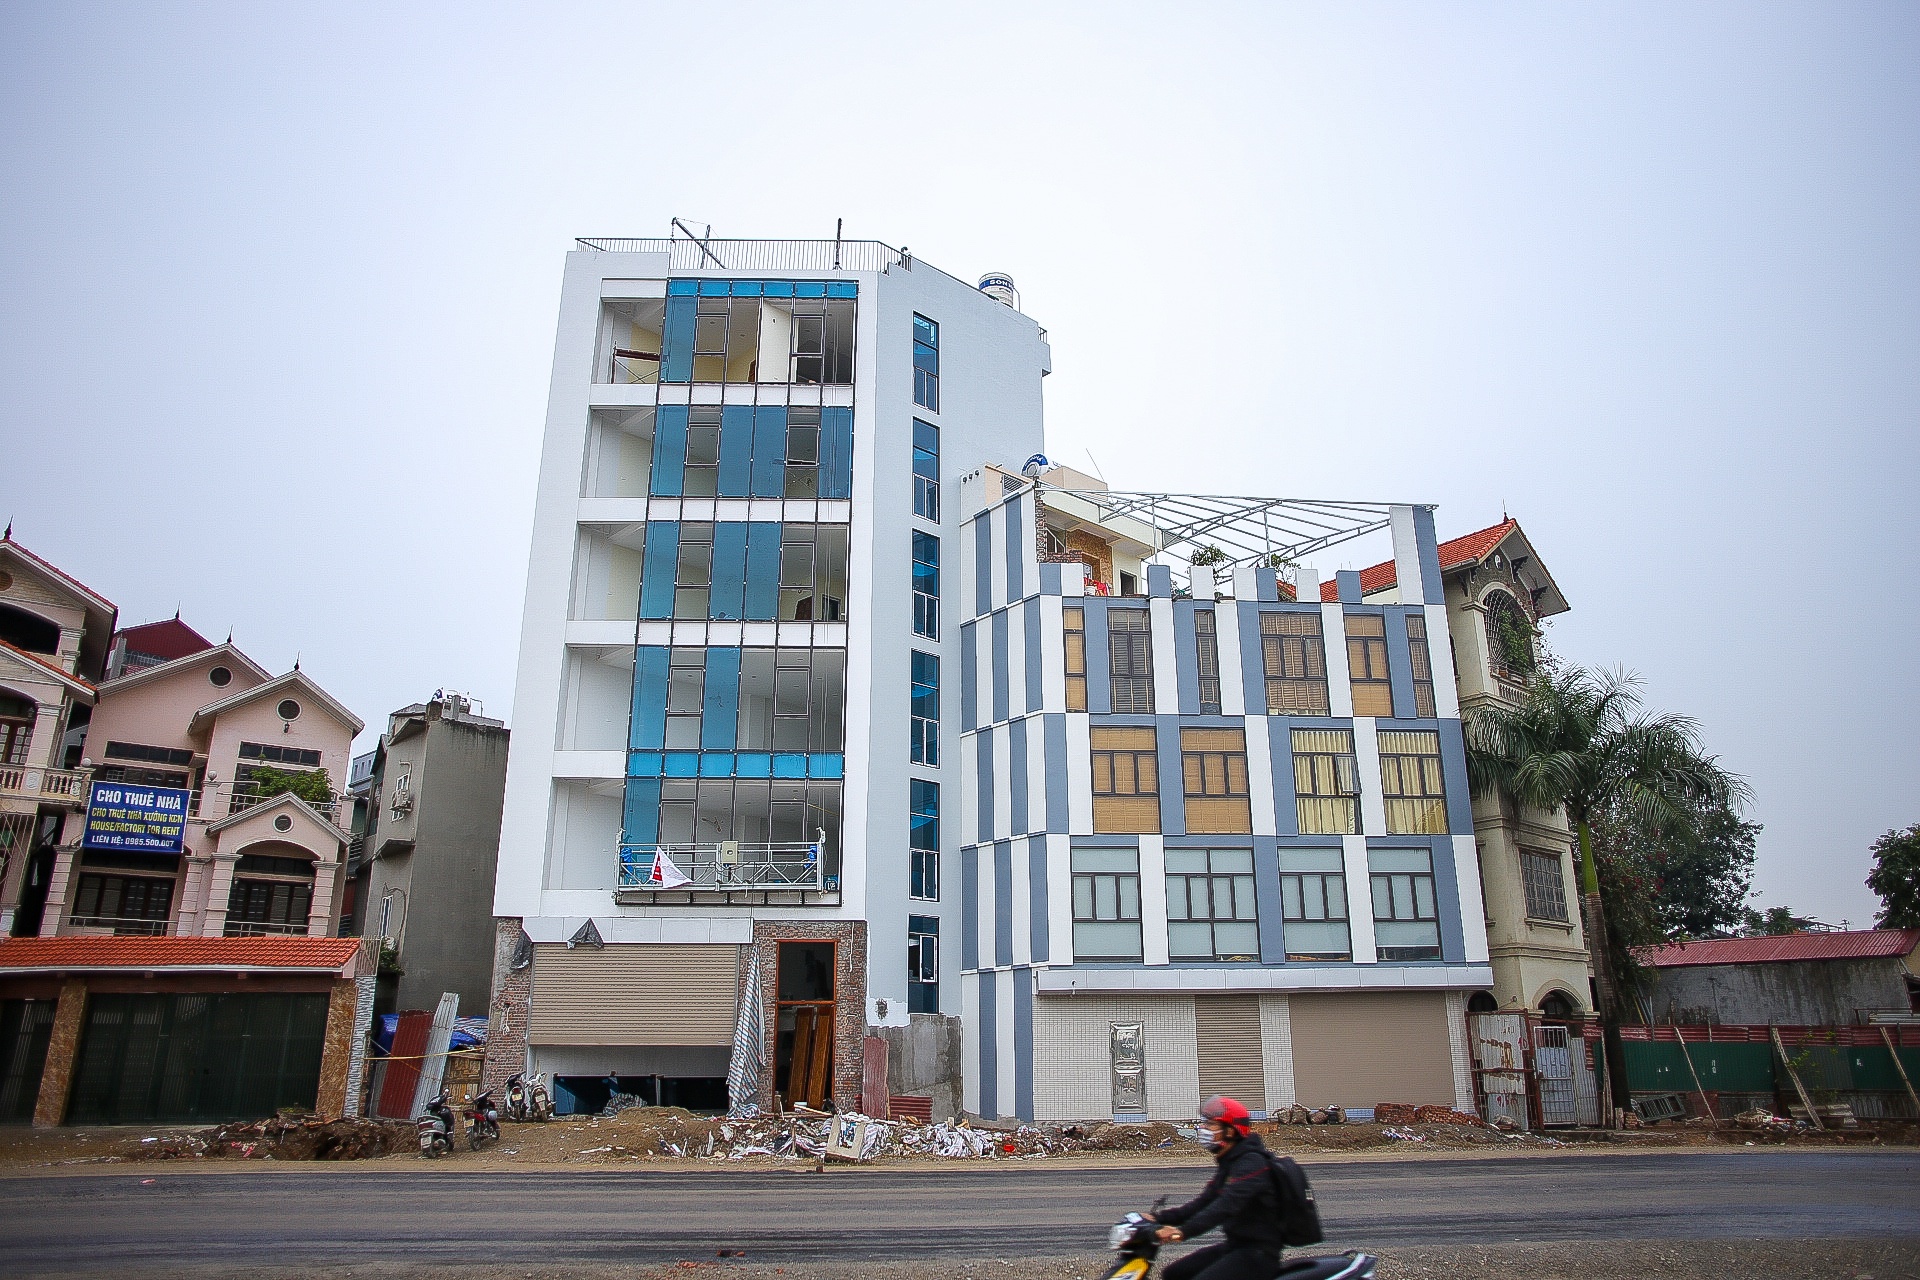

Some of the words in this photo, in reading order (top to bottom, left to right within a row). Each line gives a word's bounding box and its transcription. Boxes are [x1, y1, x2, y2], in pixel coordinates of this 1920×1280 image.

[97, 789, 121, 803] CHO
[125, 792, 154, 806] THUÊ
[156, 795, 180, 809] NHÀ
[92, 808, 106, 817] CHO
[109, 808, 126, 818] THUÊ
[90, 821, 146, 833] HOUSE/FACTORY
[147, 825, 160, 834] FOR
[162, 827, 180, 835] RENT
[92, 835, 109, 843] LIÊN
